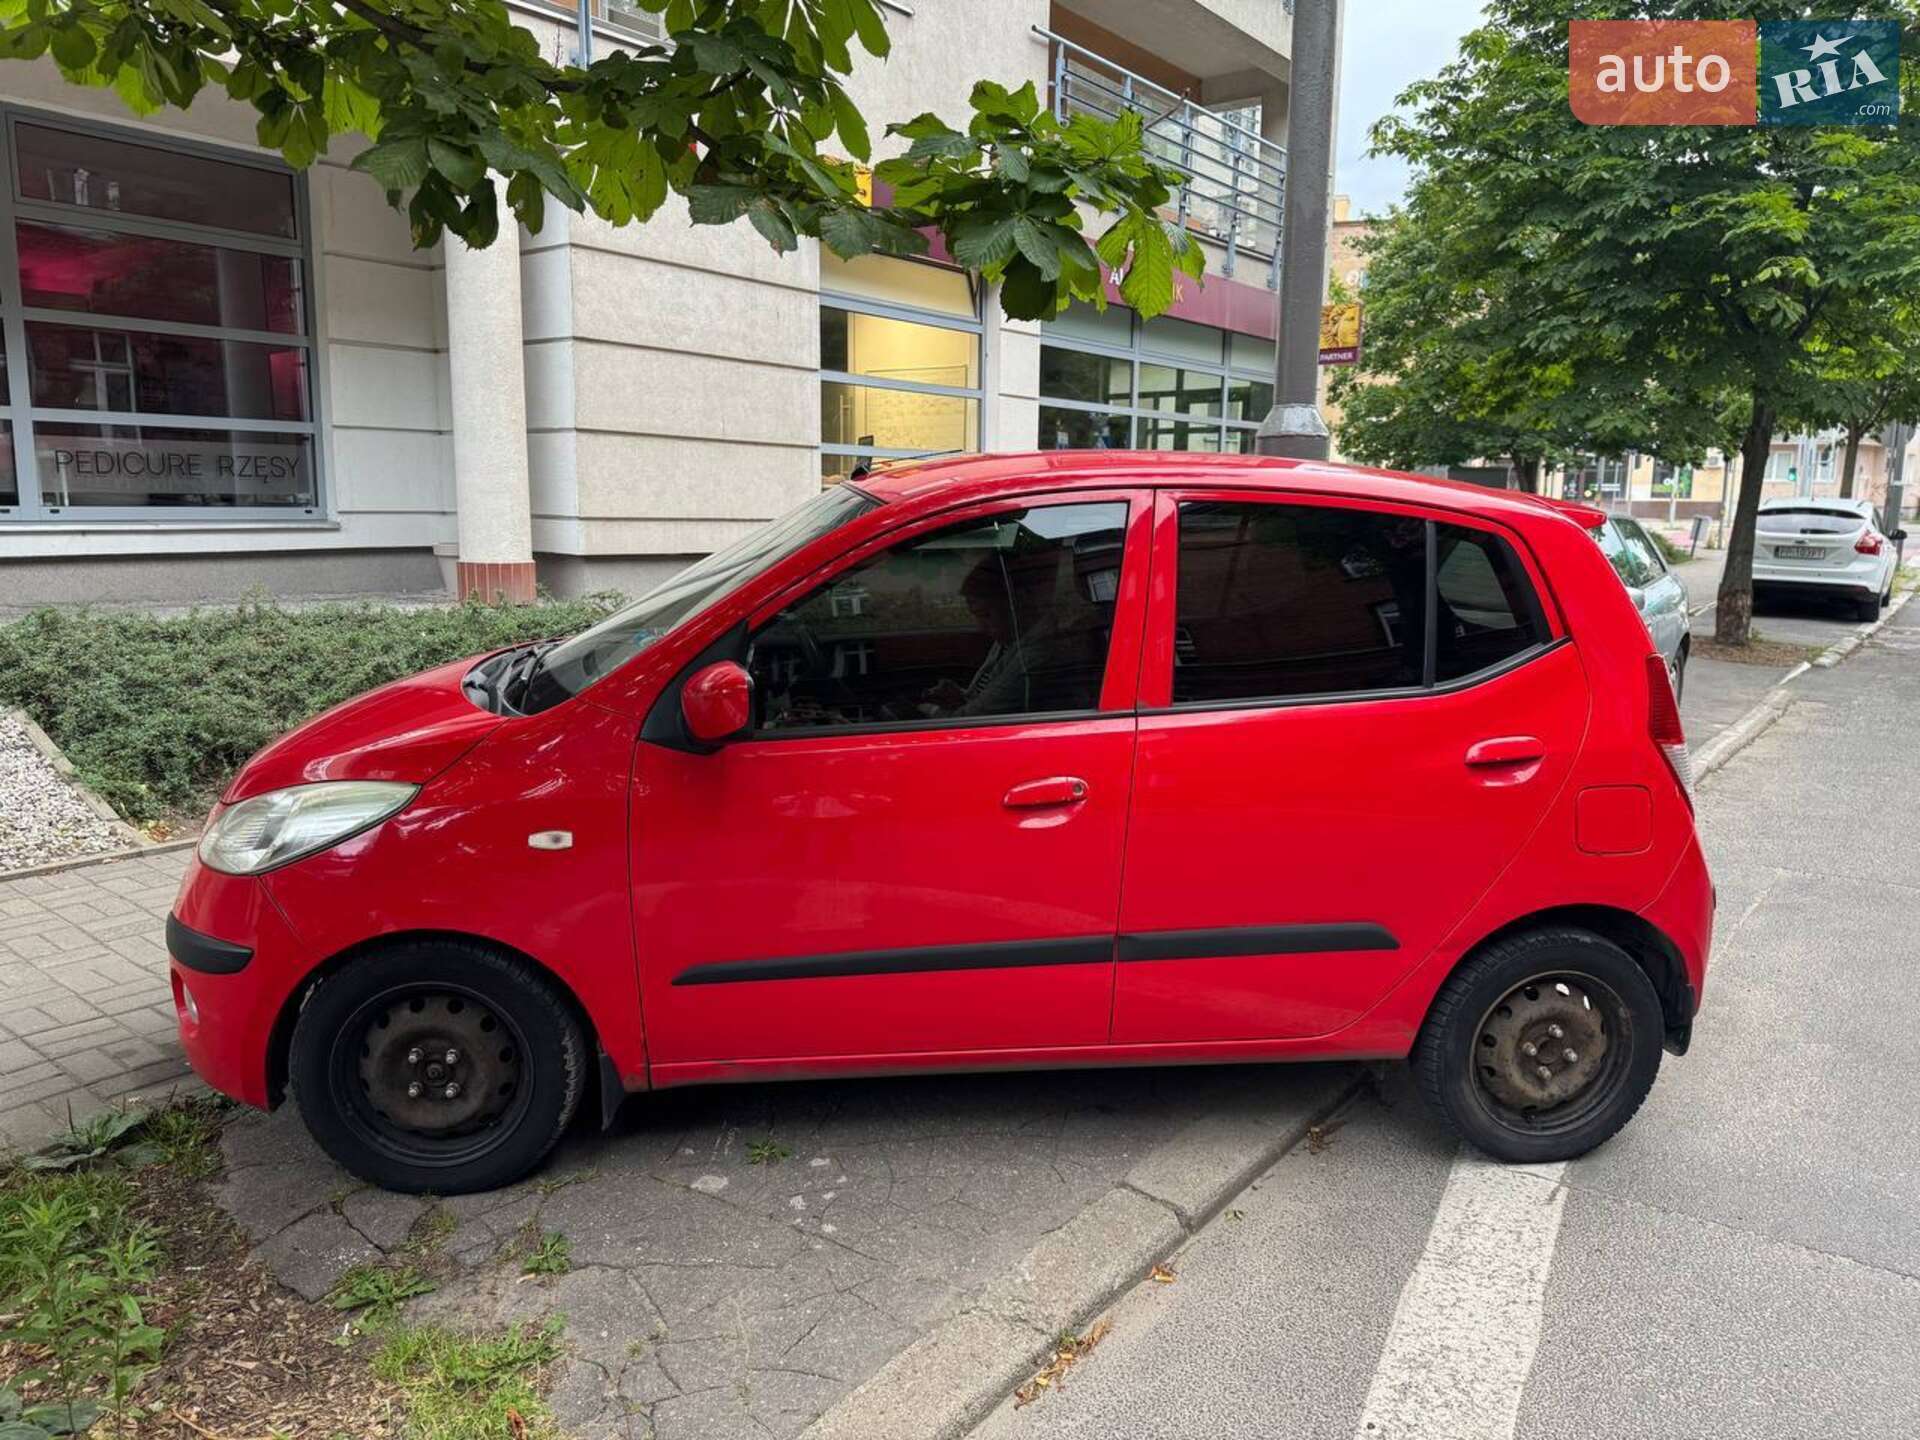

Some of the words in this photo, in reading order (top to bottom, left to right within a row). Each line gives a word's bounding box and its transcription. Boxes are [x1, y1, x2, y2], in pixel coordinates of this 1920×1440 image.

[1319, 351, 1353, 361] PARTNER
[55, 449, 202, 477] PEDICURE
[216, 455, 300, 484] RZĘSY
